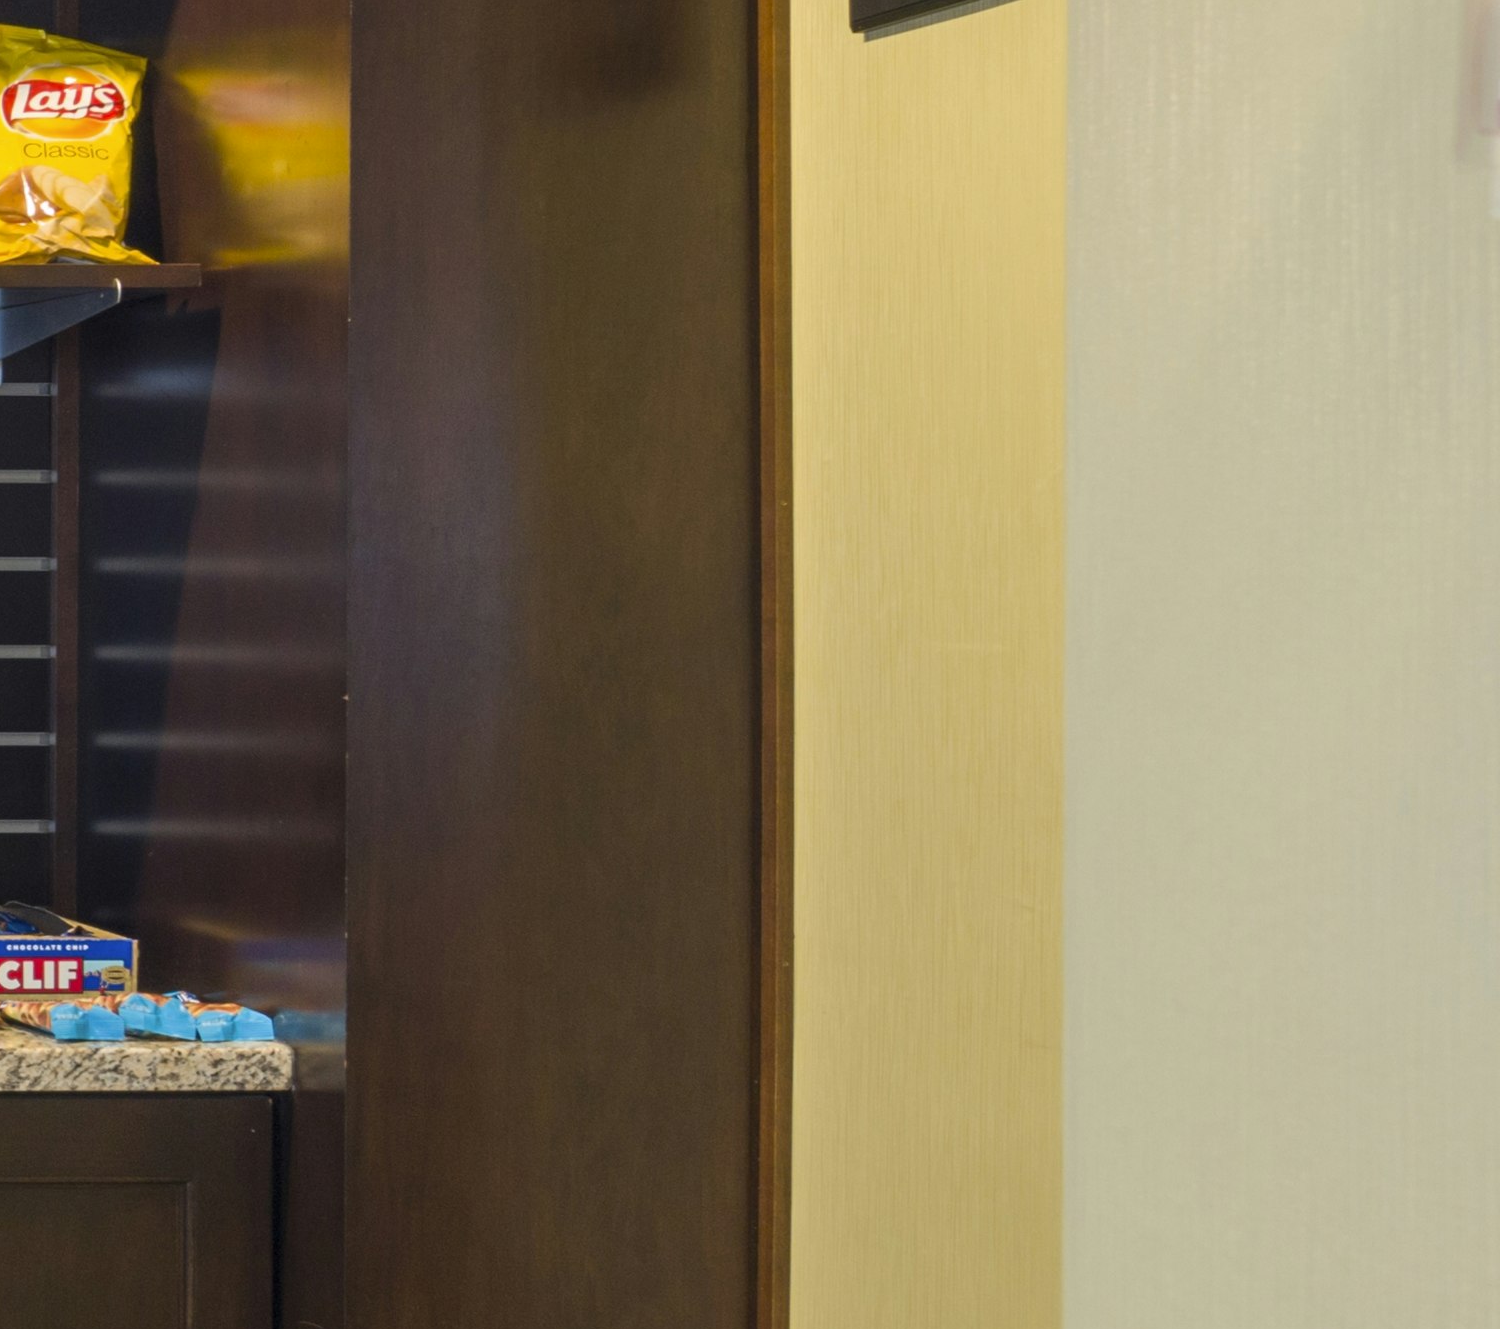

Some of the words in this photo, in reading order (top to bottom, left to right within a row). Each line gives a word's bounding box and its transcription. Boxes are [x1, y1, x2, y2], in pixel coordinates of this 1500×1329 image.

[9, 81, 121, 121] Lay's
[23, 142, 109, 161] Classic
[6, 944, 62, 952] CHOCOLATE
